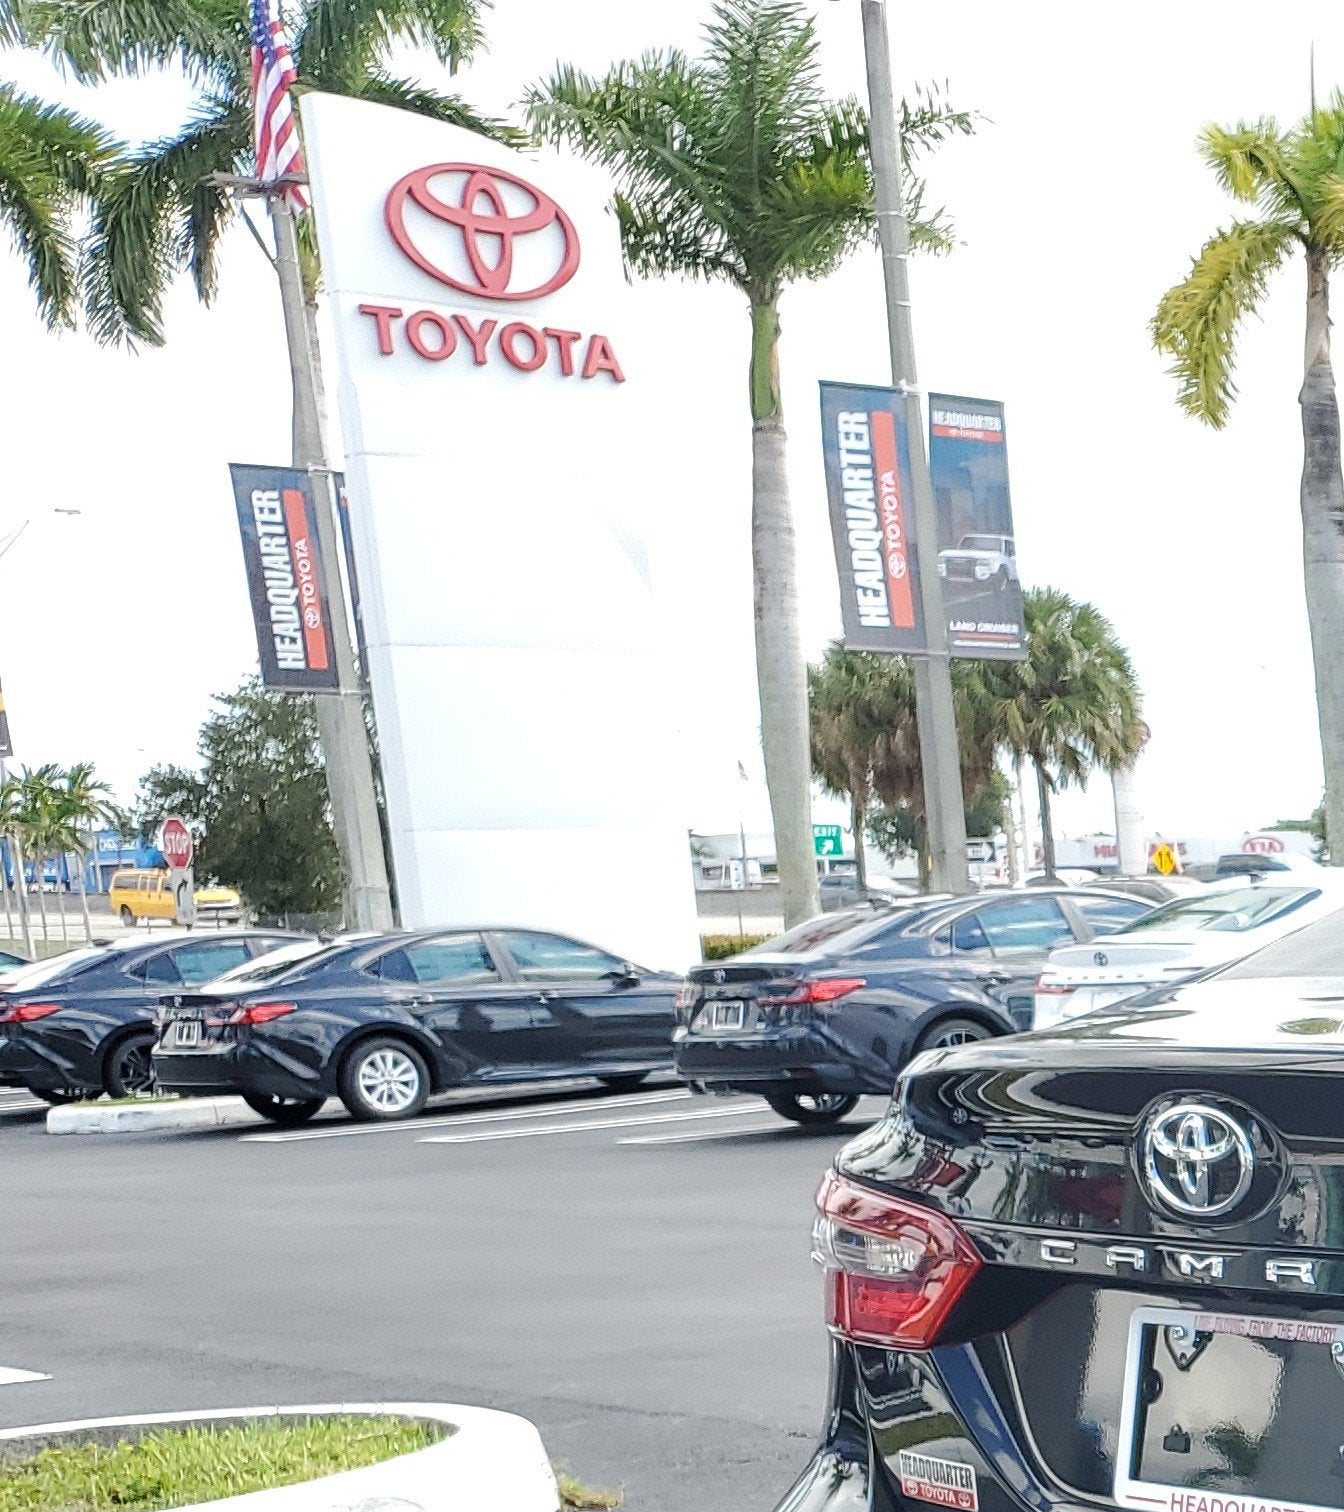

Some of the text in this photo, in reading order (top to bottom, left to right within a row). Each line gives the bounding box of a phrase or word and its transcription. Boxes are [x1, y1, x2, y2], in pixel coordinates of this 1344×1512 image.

[359, 303, 626, 383] TOYOTA
[837, 410, 891, 627] HEADQUARTER
[879, 469, 903, 551] TOYOTA
[251, 488, 306, 670] HEADQUARTER
[294, 537, 316, 605] TOYOTA
[164, 831, 188, 854] STOP
[901, 1453, 974, 1491] HEADQUARTER
[920, 1484, 956, 1504] TOYOTA
